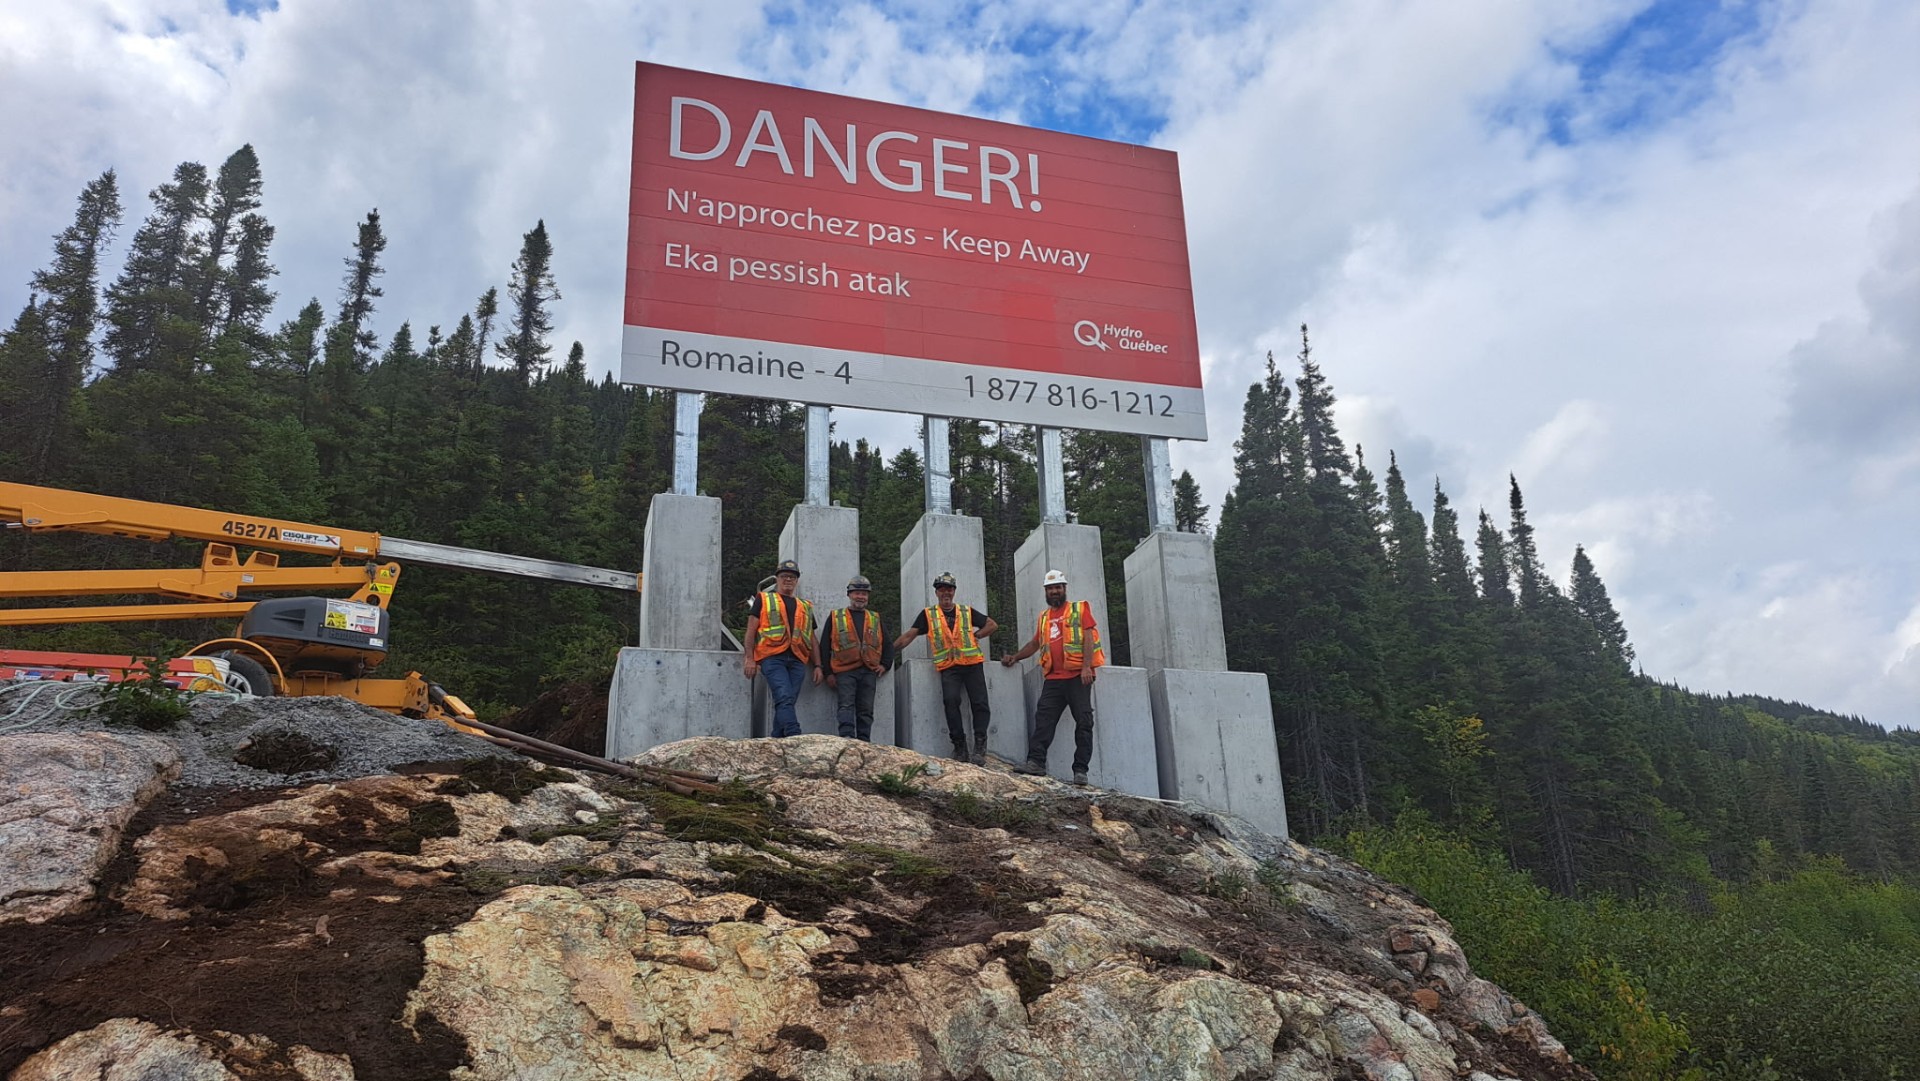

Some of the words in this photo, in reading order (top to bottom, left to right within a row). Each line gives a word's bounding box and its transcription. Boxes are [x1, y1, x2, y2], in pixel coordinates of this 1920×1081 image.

[669, 96, 1042, 212] DANGER!
[667, 188, 860, 237] N'approchez
[868, 222, 916, 245] pas
[942, 228, 1011, 262] Keep
[1019, 239, 1090, 273] Away
[665, 242, 718, 272] Eka
[729, 257, 839, 288] pessish
[848, 272, 910, 297] atak
[1103, 324, 1142, 339] Hydro
[1119, 338, 1168, 353] Québec
[661, 340, 805, 380] Romaine
[834, 361, 853, 384] 4
[964, 375, 974, 398] 1
[988, 377, 1038, 403] 877
[1048, 383, 1175, 417] 816-1212
[222, 520, 279, 540] 4527A
